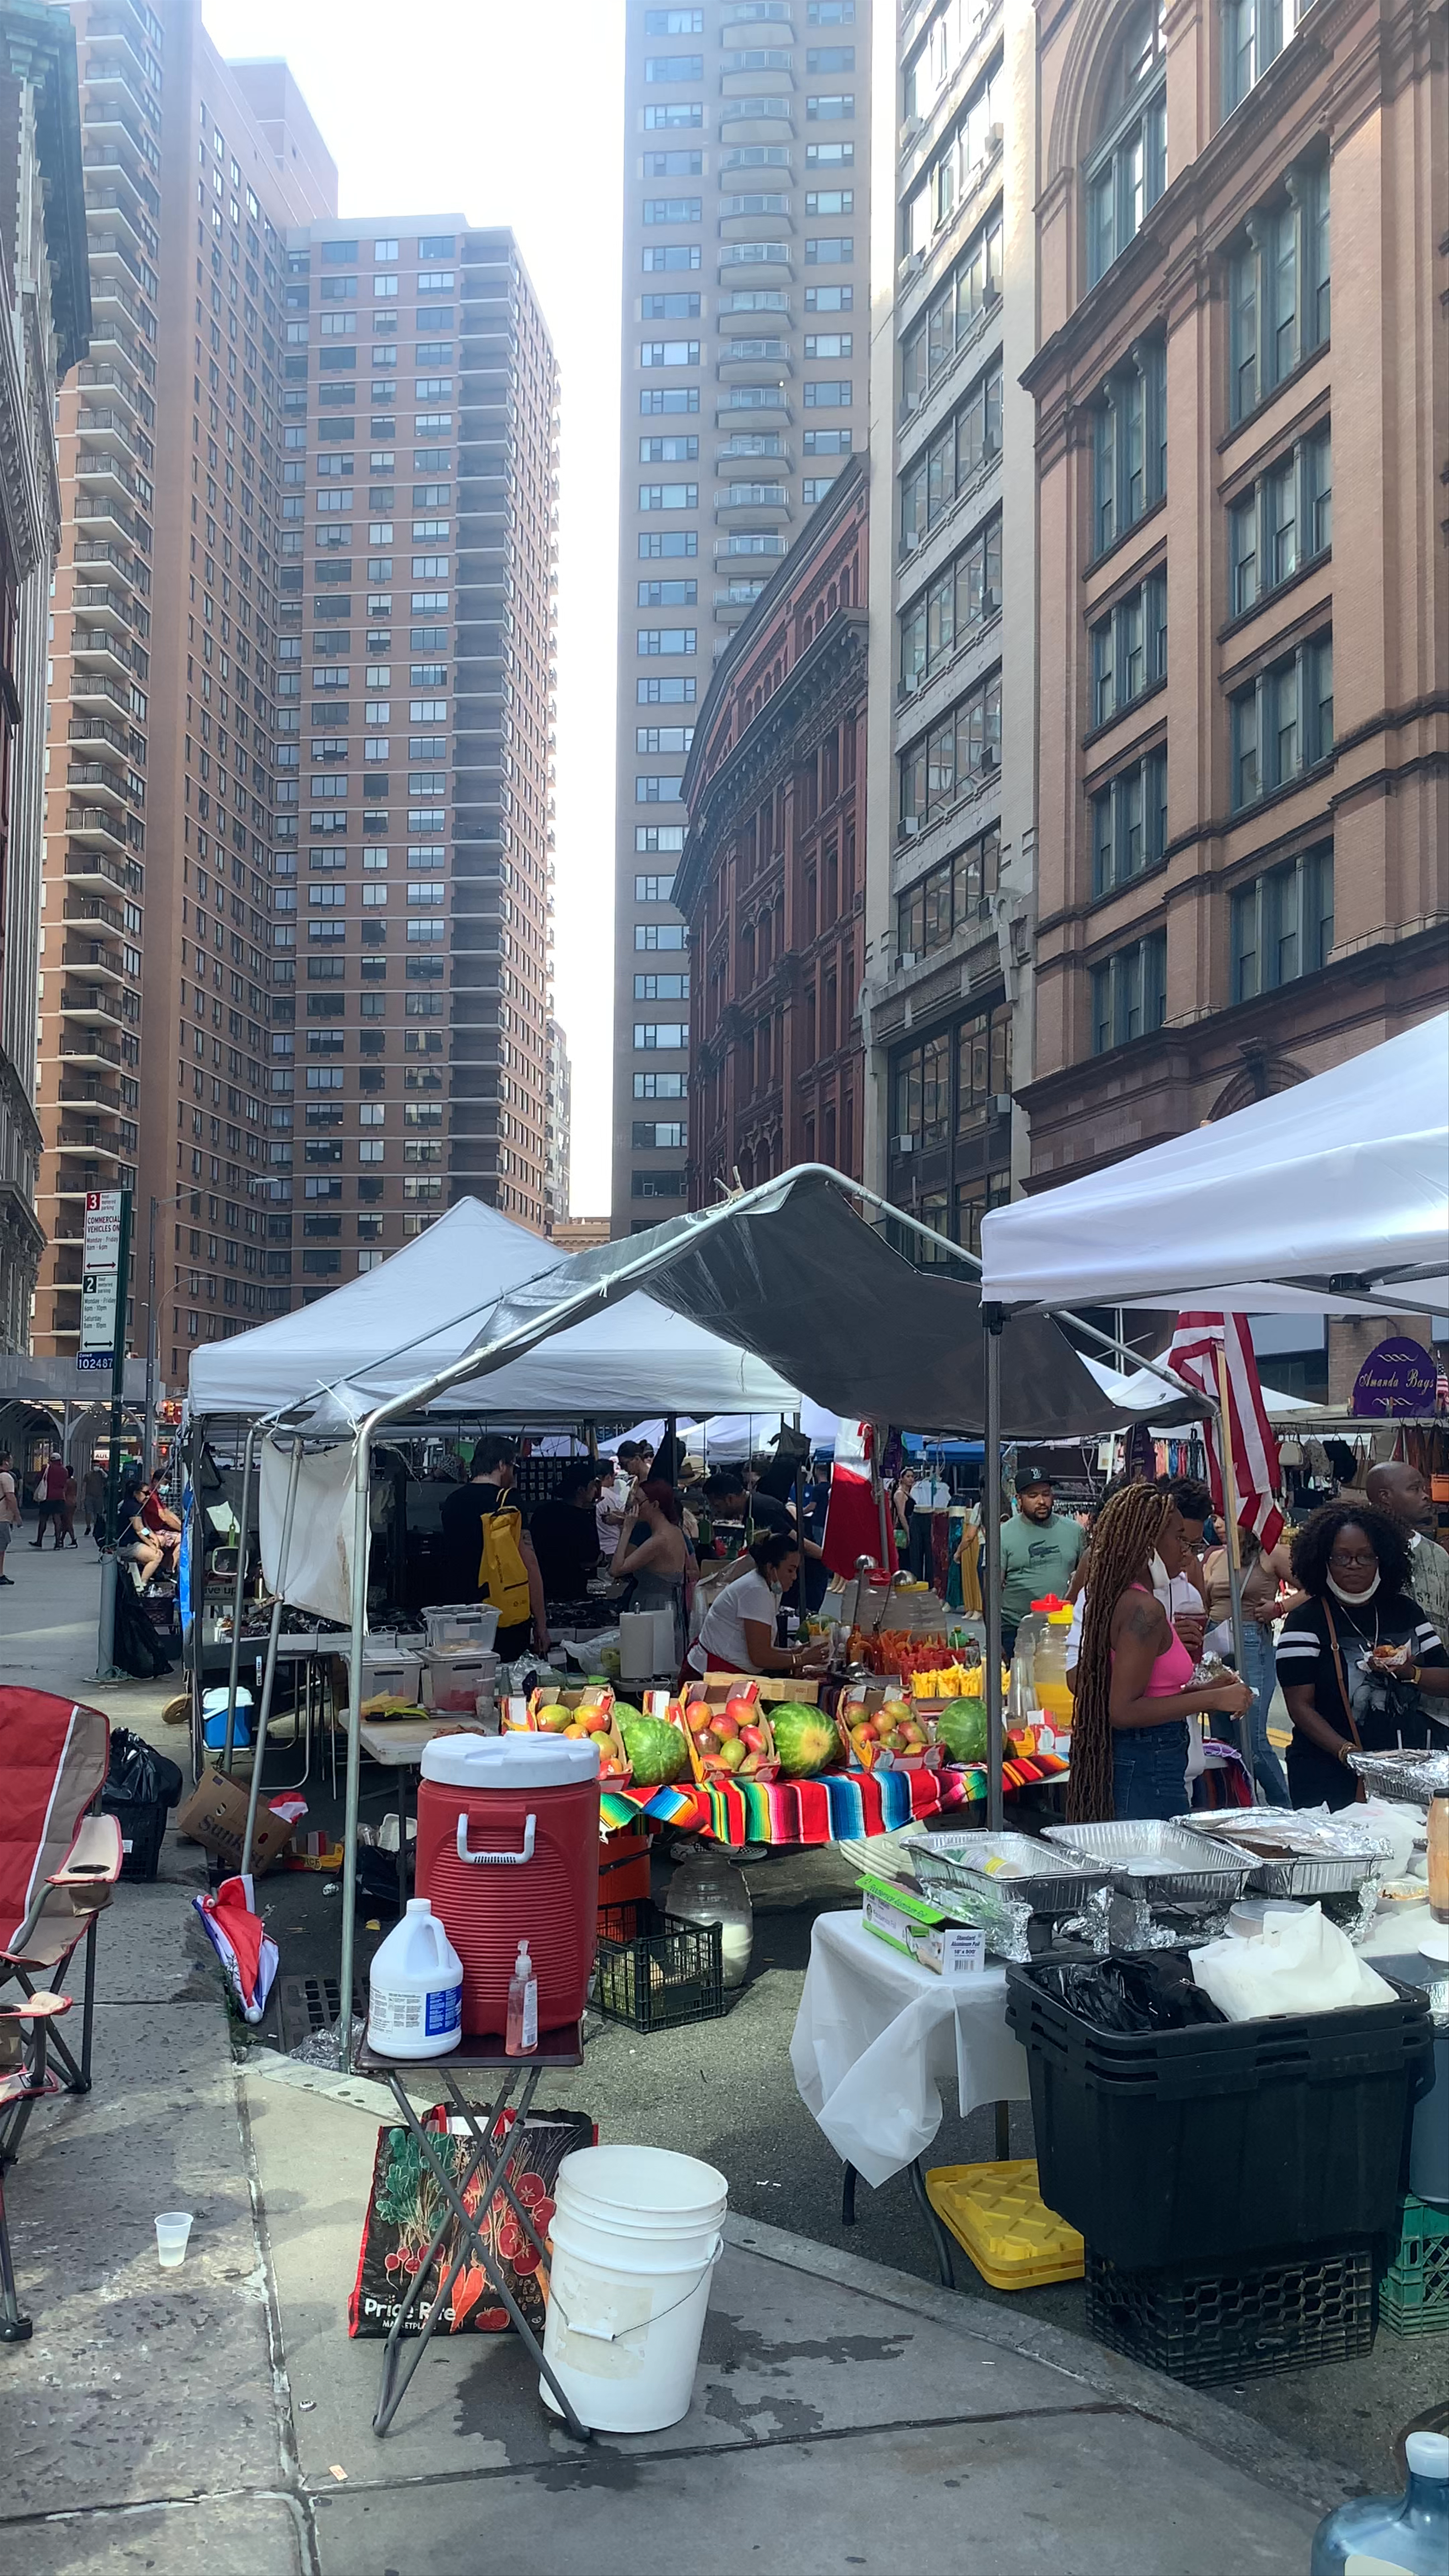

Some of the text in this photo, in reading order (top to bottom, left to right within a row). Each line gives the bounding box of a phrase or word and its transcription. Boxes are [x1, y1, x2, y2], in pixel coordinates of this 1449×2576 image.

[90, 1194, 97, 1209] 3
[88, 1216, 120, 1224] COMMERCIAL
[88, 1225, 111, 1233] VEHICLES
[86, 1277, 94, 1292] 2
[79, 1358, 113, 1369] 102487
[1359, 1369, 1434, 1395] Amanda Bags
